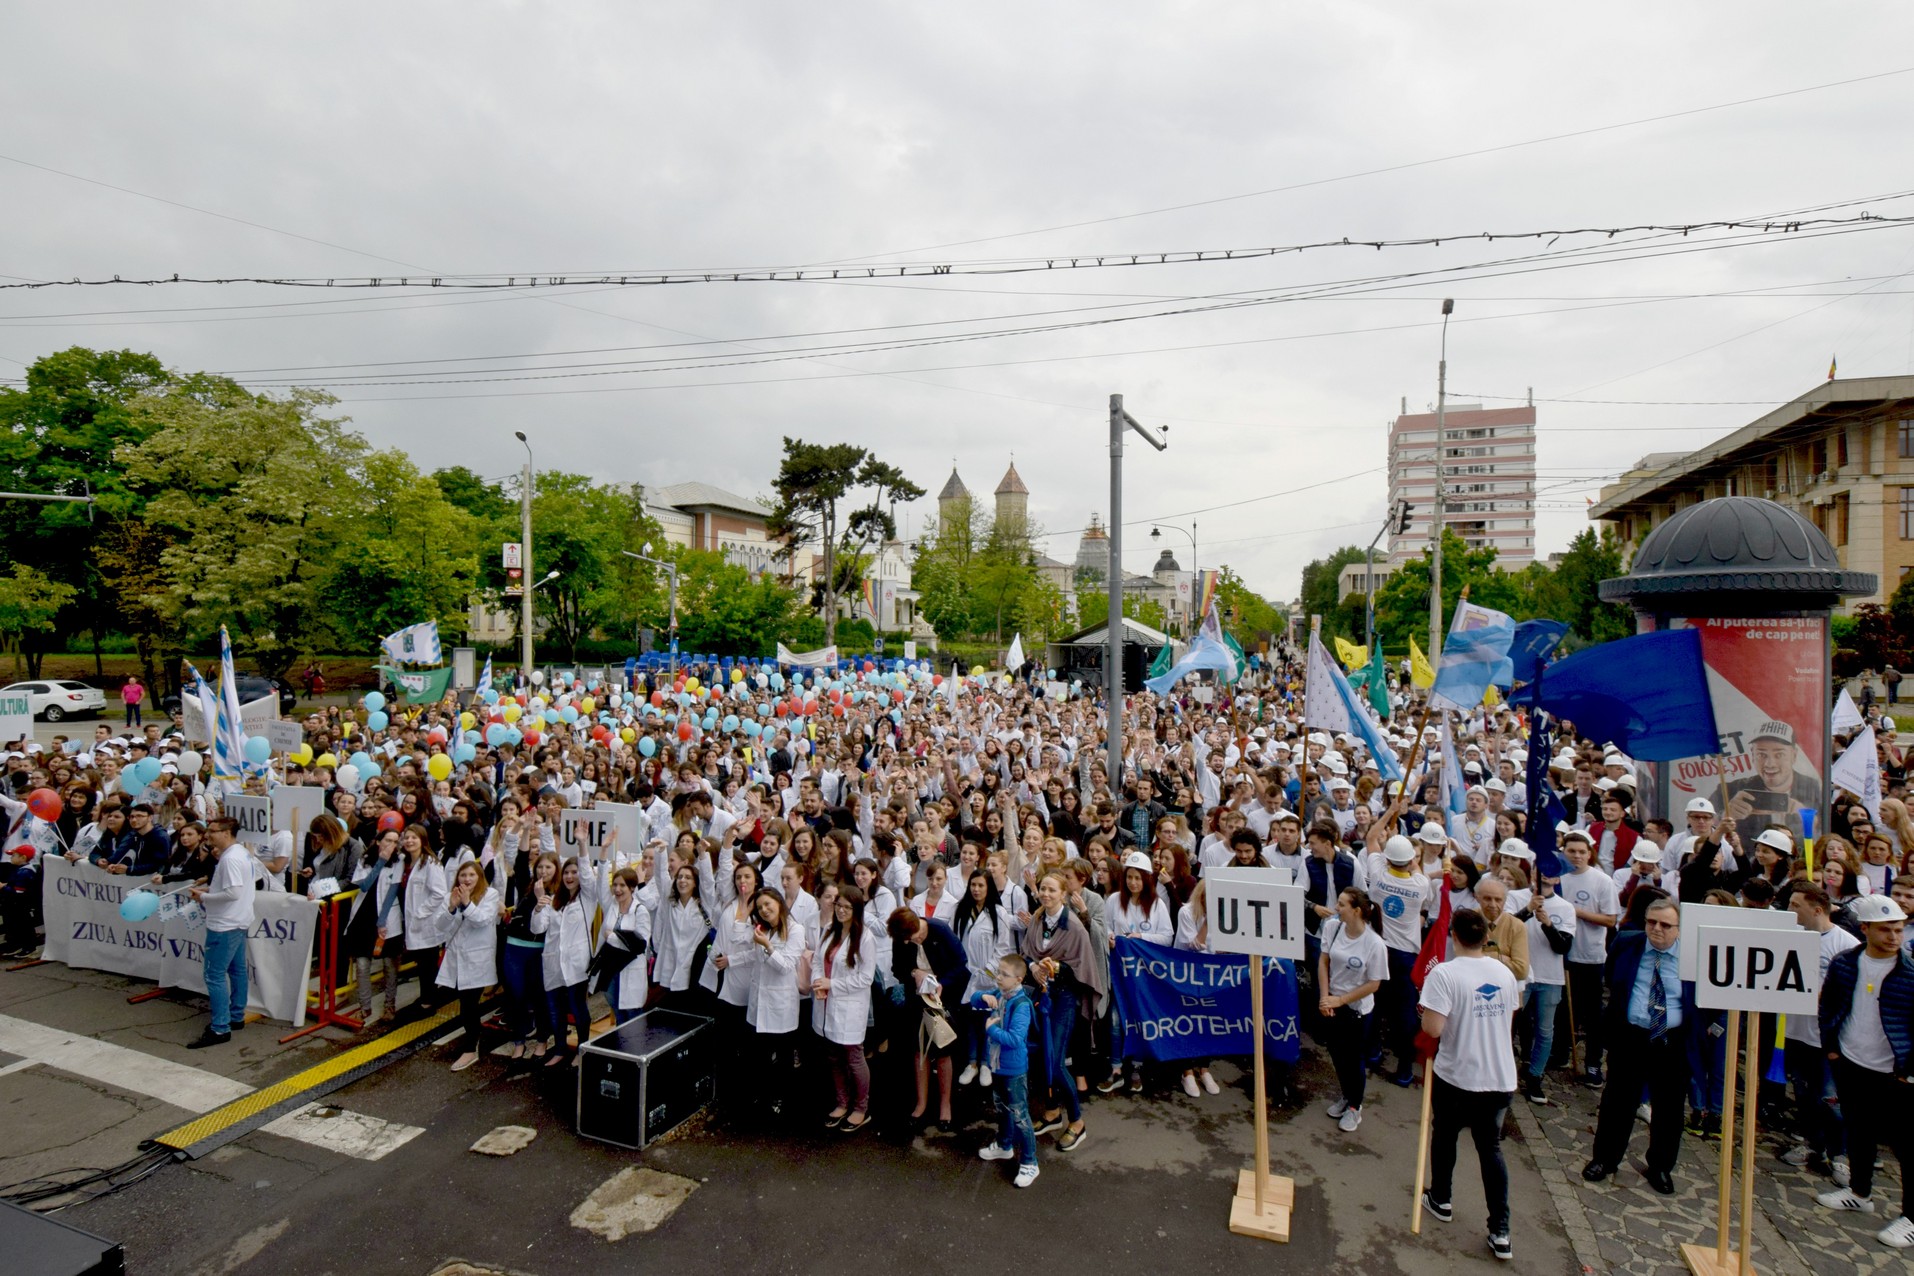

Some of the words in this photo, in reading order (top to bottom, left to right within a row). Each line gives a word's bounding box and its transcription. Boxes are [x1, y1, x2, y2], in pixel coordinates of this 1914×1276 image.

[1723, 617, 1777, 629] puterea
[1746, 629, 1763, 640] de
[1766, 630, 1788, 642] cap
[1790, 631, 1803, 642] pe
[1376, 881, 1419, 898] INGINER
[246, 917, 297, 945] AȘI
[1217, 897, 1295, 941] U.T.I.
[72, 921, 117, 945] ZIUA
[1121, 956, 1285, 988] FACULTATA
[1708, 944, 1813, 994] U.P.A.
[1181, 995, 1218, 1007] DE
